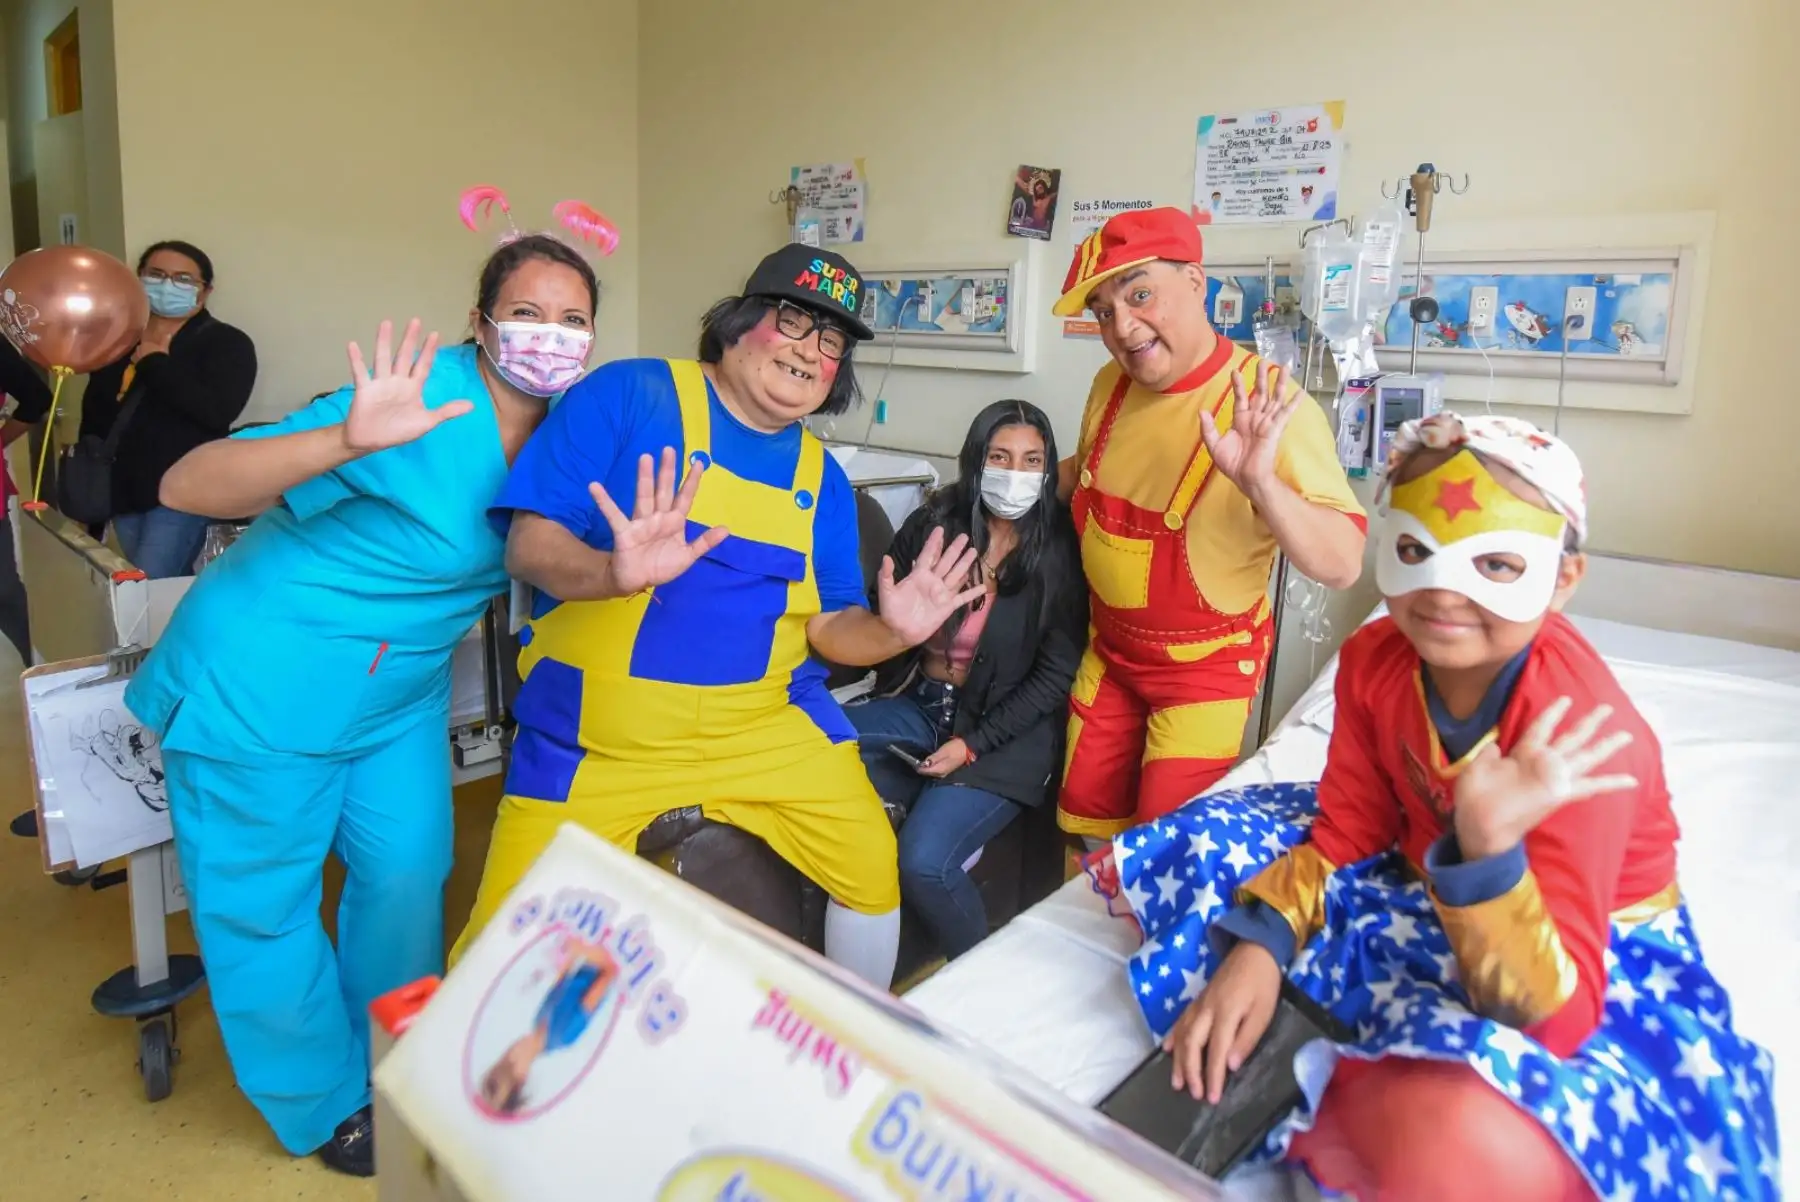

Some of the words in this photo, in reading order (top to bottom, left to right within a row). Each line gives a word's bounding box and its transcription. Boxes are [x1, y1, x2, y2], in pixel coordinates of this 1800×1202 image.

[1073, 201, 1091, 211] Sus
[1094, 201, 1099, 210] 5
[1102, 200, 1153, 210] Momentos
[794, 269, 857, 312] MARIO
[809, 258, 859, 294] SUPER
[756, 987, 850, 1089] Swing
[870, 1089, 1020, 1202] king
